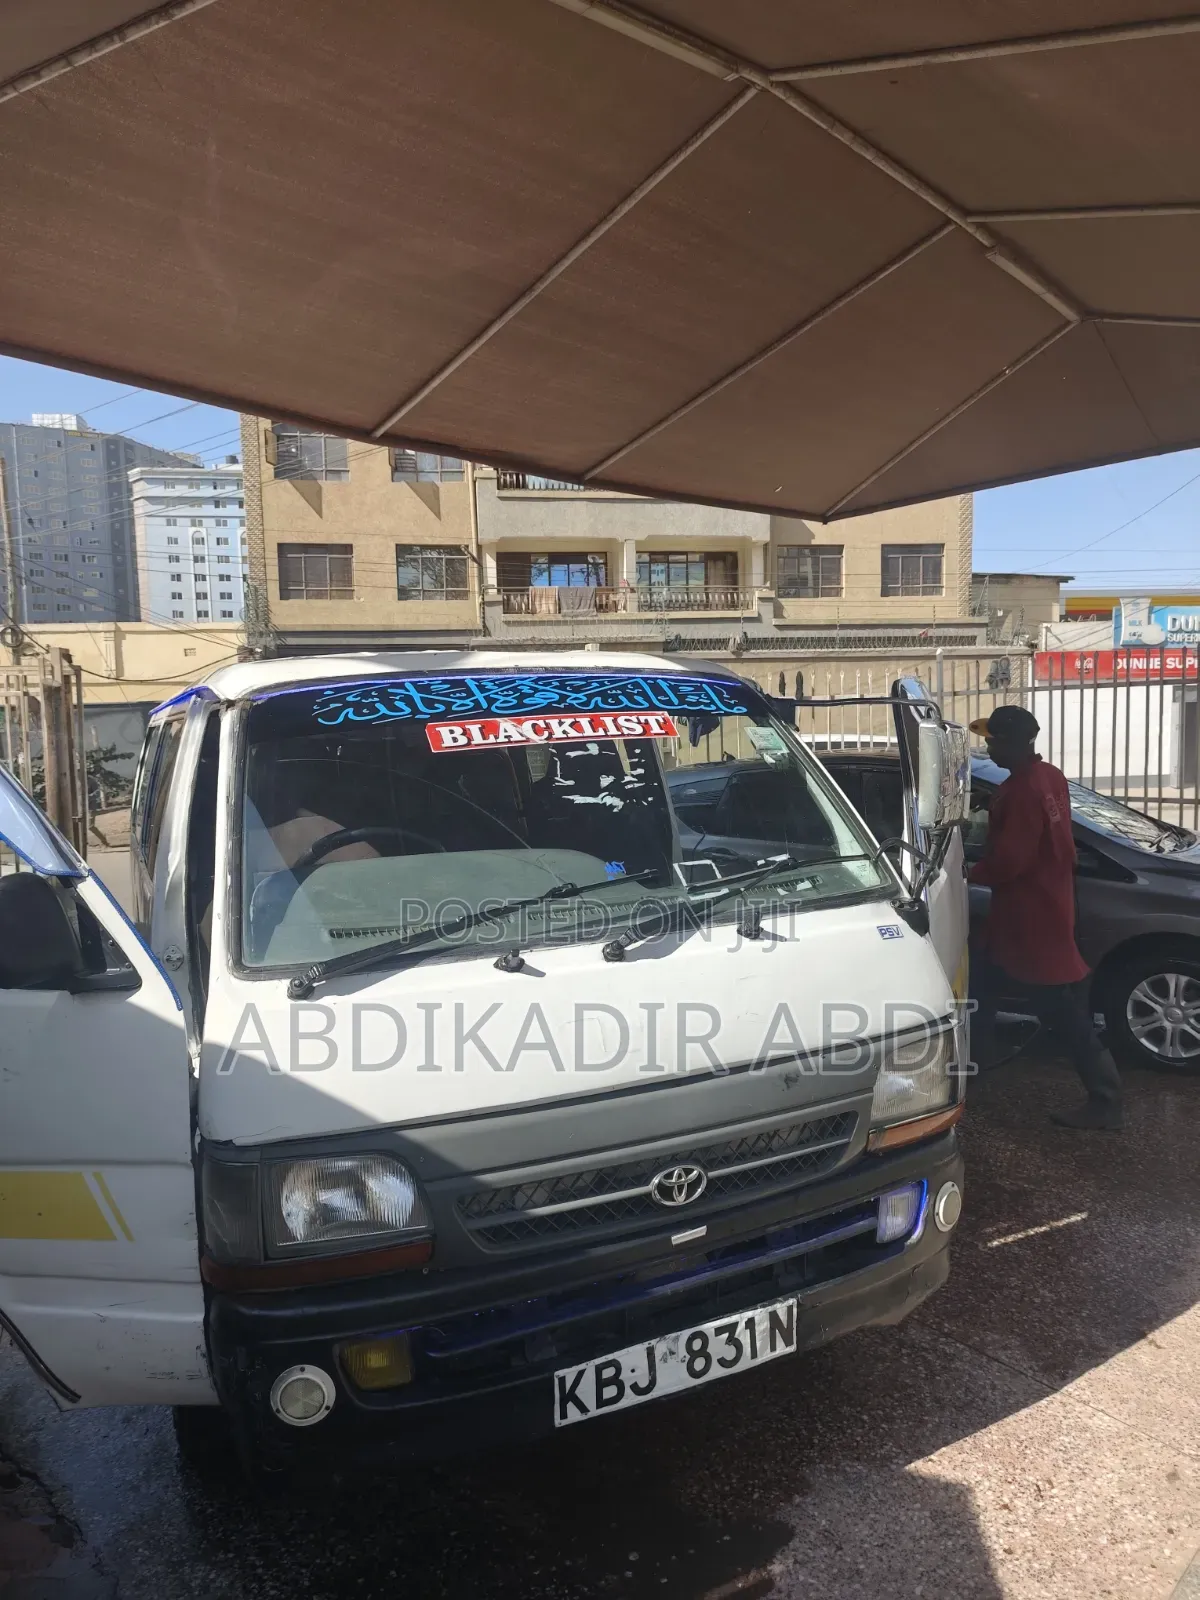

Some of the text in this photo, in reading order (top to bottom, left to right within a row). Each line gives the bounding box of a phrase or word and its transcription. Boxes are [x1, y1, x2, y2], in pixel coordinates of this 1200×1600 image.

[435, 715, 668, 749] BLACKLIST
[878, 926, 901, 938] PSV
[557, 1303, 796, 1421] KBJ 831N
